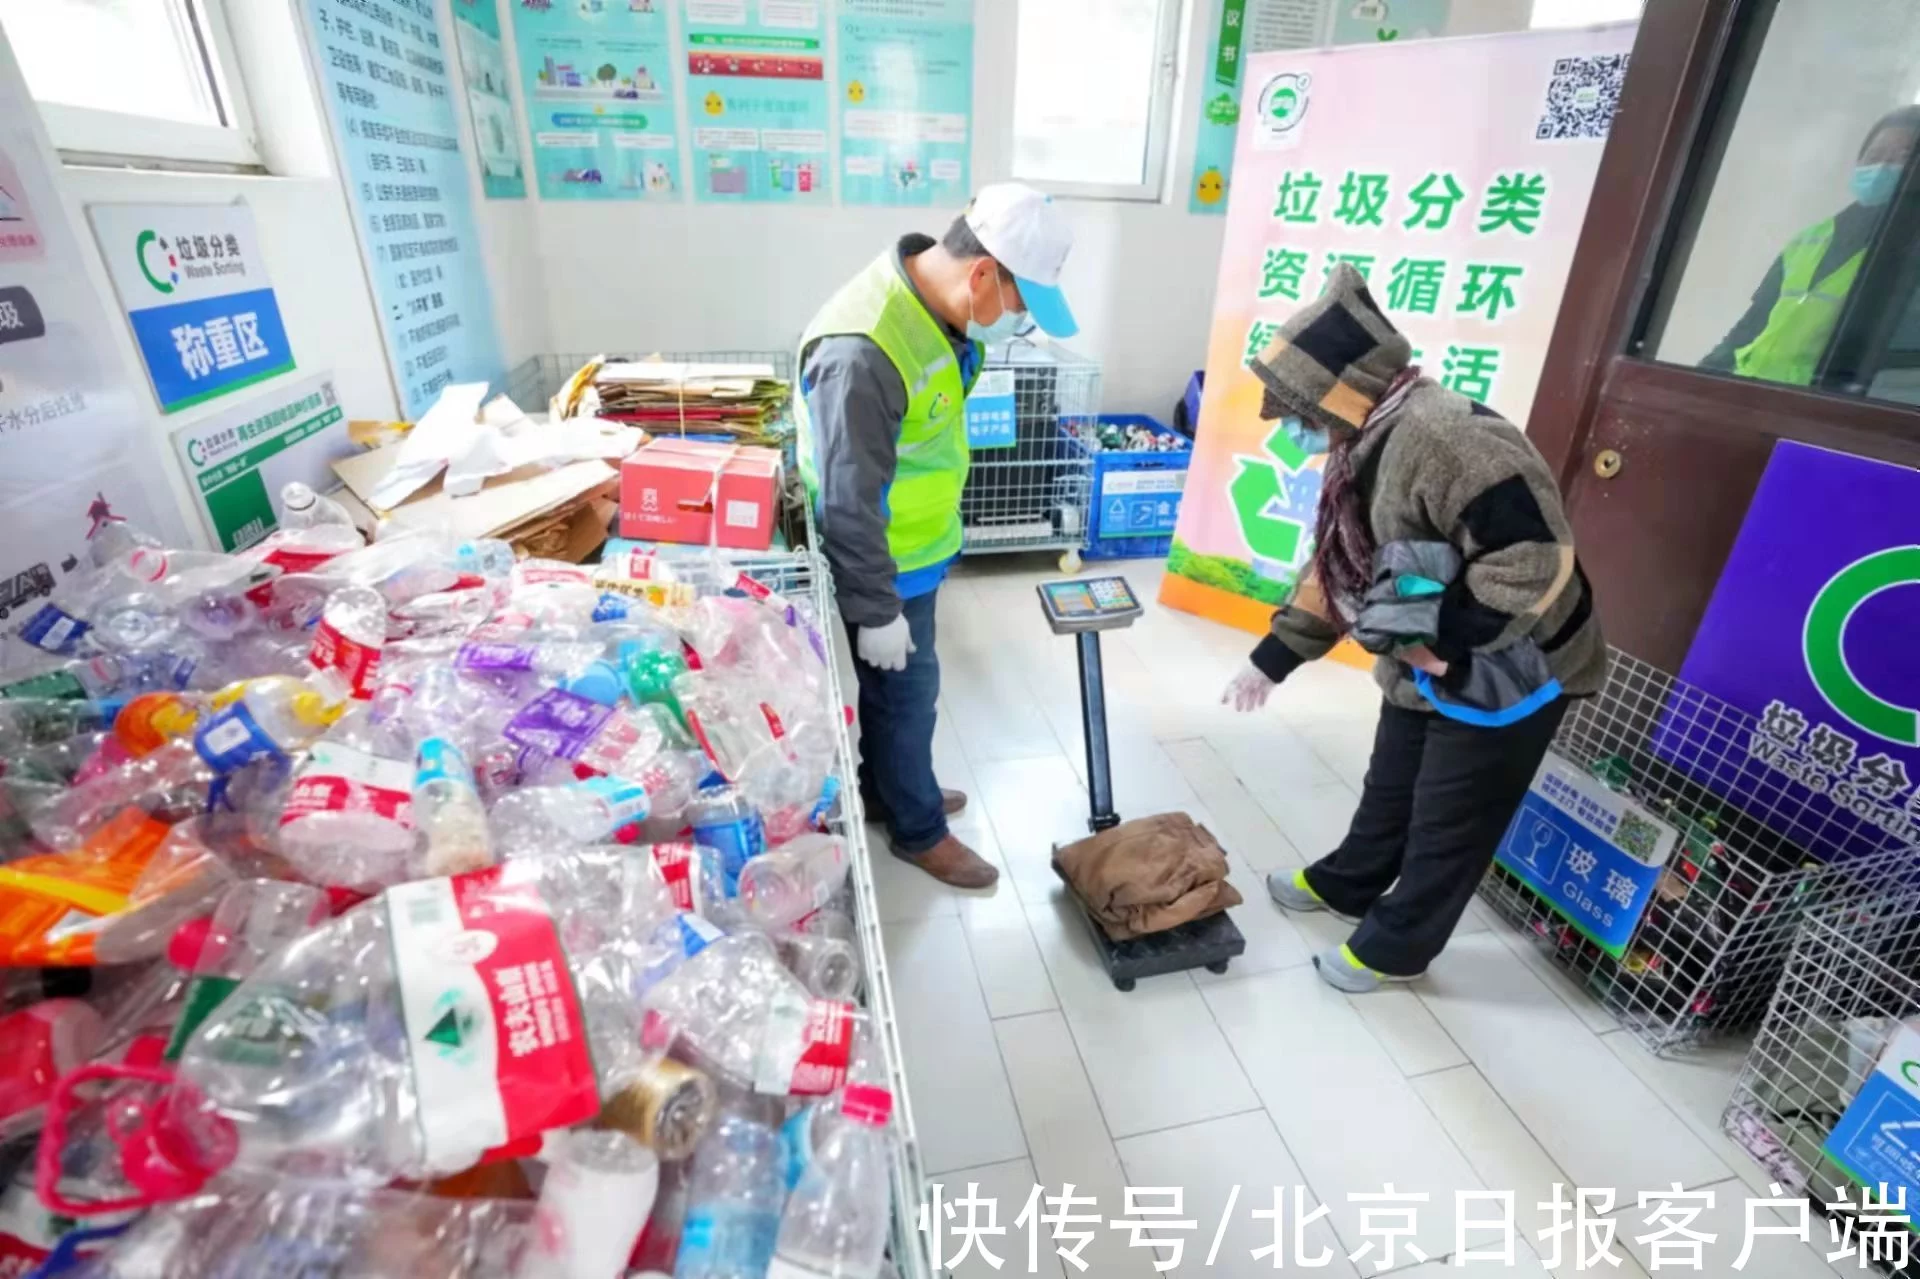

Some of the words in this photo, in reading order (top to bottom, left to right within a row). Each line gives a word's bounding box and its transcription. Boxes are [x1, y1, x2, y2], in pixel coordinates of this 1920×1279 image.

[1273, 171, 1546, 235] 垃圾分类
[175, 233, 242, 260] 垃圾分类
[170, 311, 270, 381] 称重区
[1750, 732, 1829, 793] Waste
[1562, 880, 1614, 928] Glass
[1565, 842, 1640, 911] 玻璃
